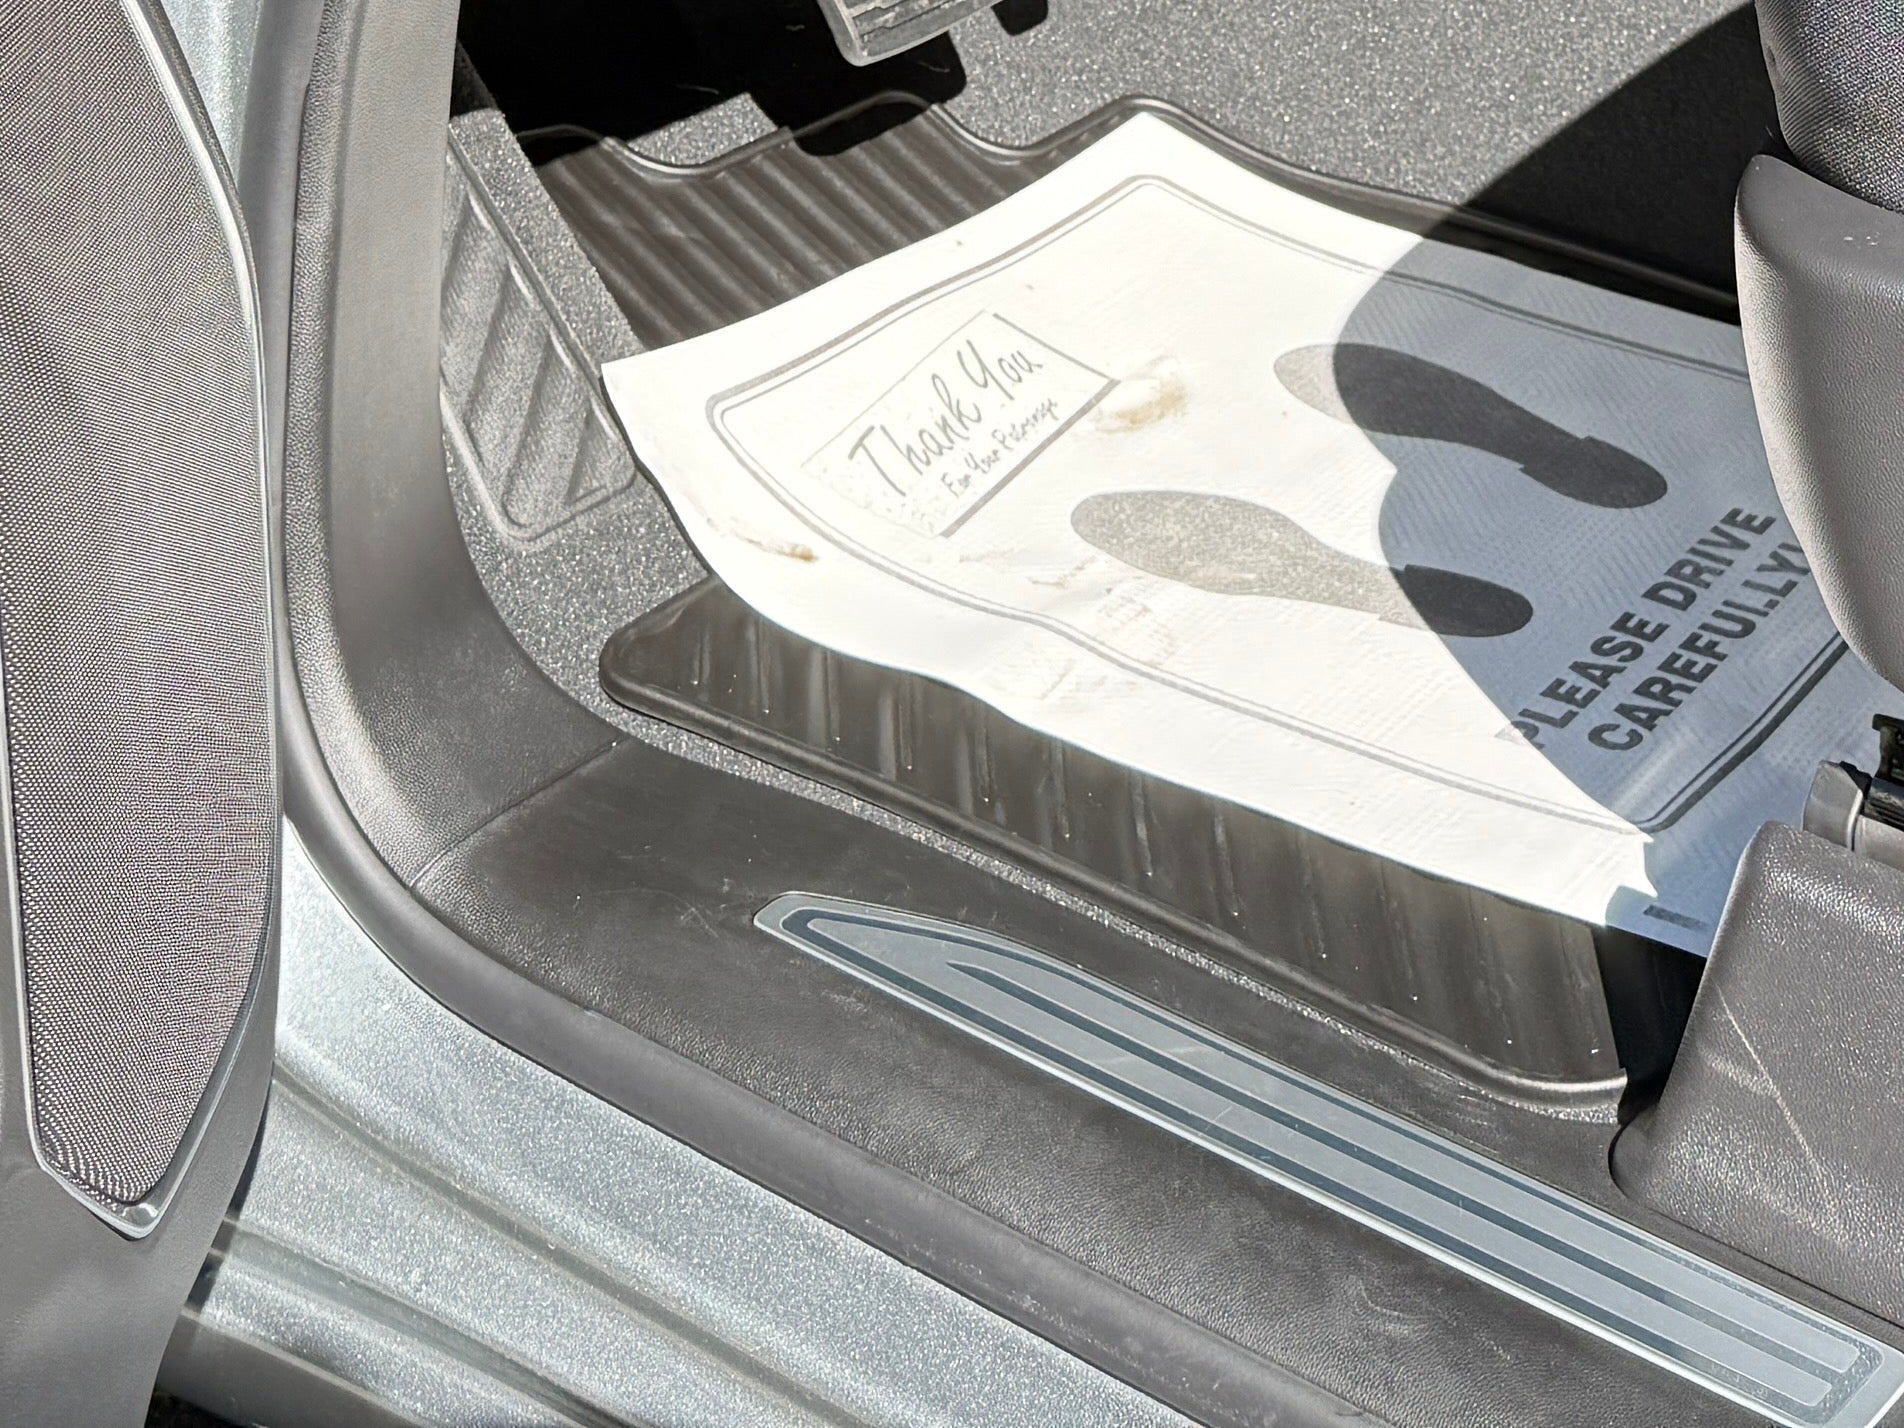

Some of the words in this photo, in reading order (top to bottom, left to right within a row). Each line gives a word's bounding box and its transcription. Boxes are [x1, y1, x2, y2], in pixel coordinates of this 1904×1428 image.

[847, 372, 982, 498] Thank
[956, 338, 1044, 401] You
[1494, 611, 1671, 751] PLEASE
[1640, 507, 1777, 612] DRIVE
